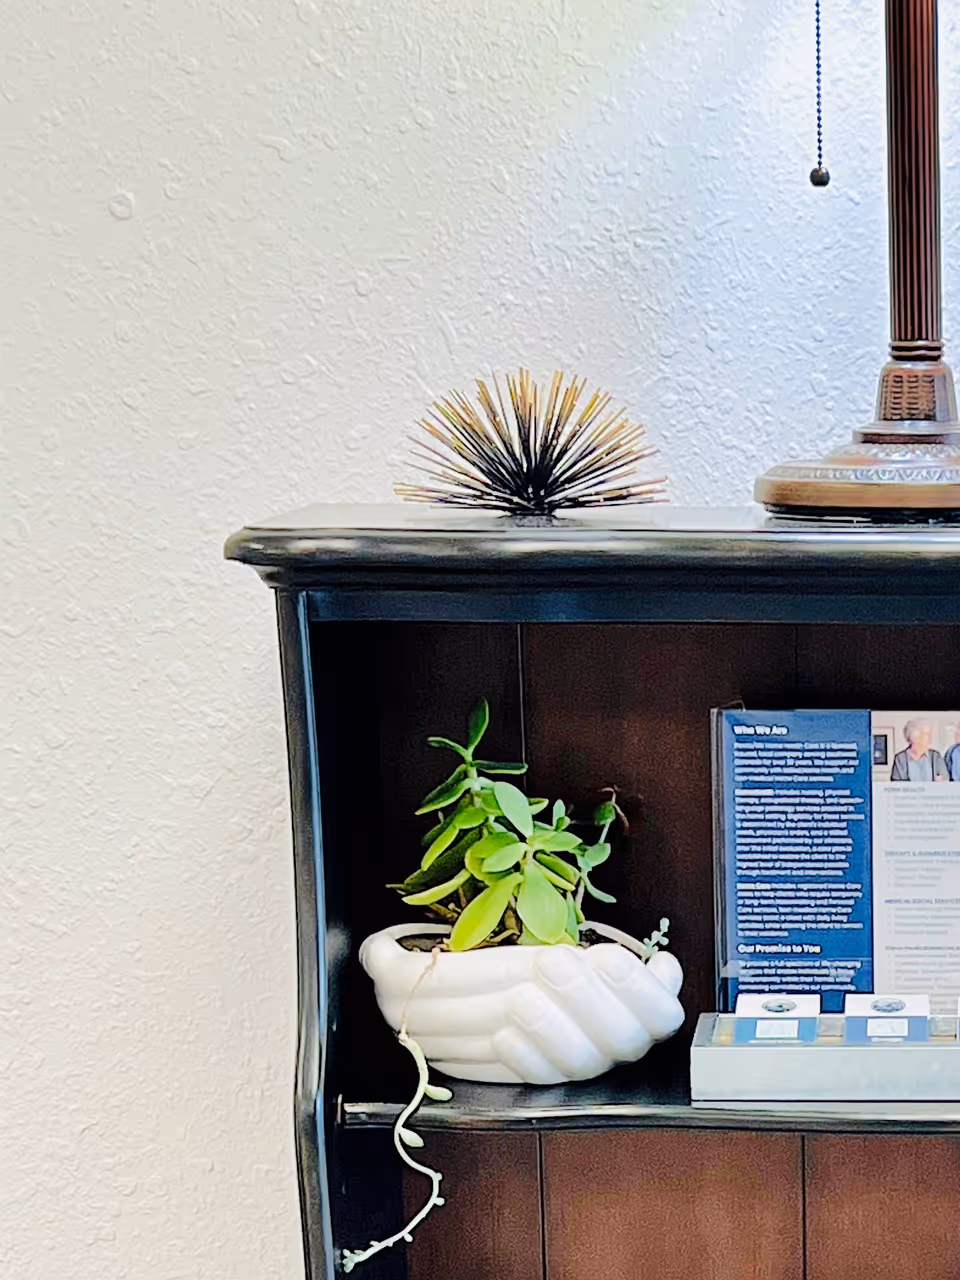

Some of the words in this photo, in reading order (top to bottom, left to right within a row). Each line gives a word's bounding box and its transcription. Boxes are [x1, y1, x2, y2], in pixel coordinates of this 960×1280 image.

[733, 725, 755, 735] Who
[755, 725, 771, 735] We
[772, 725, 788, 735] Are
[737, 943, 755, 954] Our
[755, 942, 792, 954] Promise
[792, 943, 803, 954] to
[803, 943, 821, 954] You
